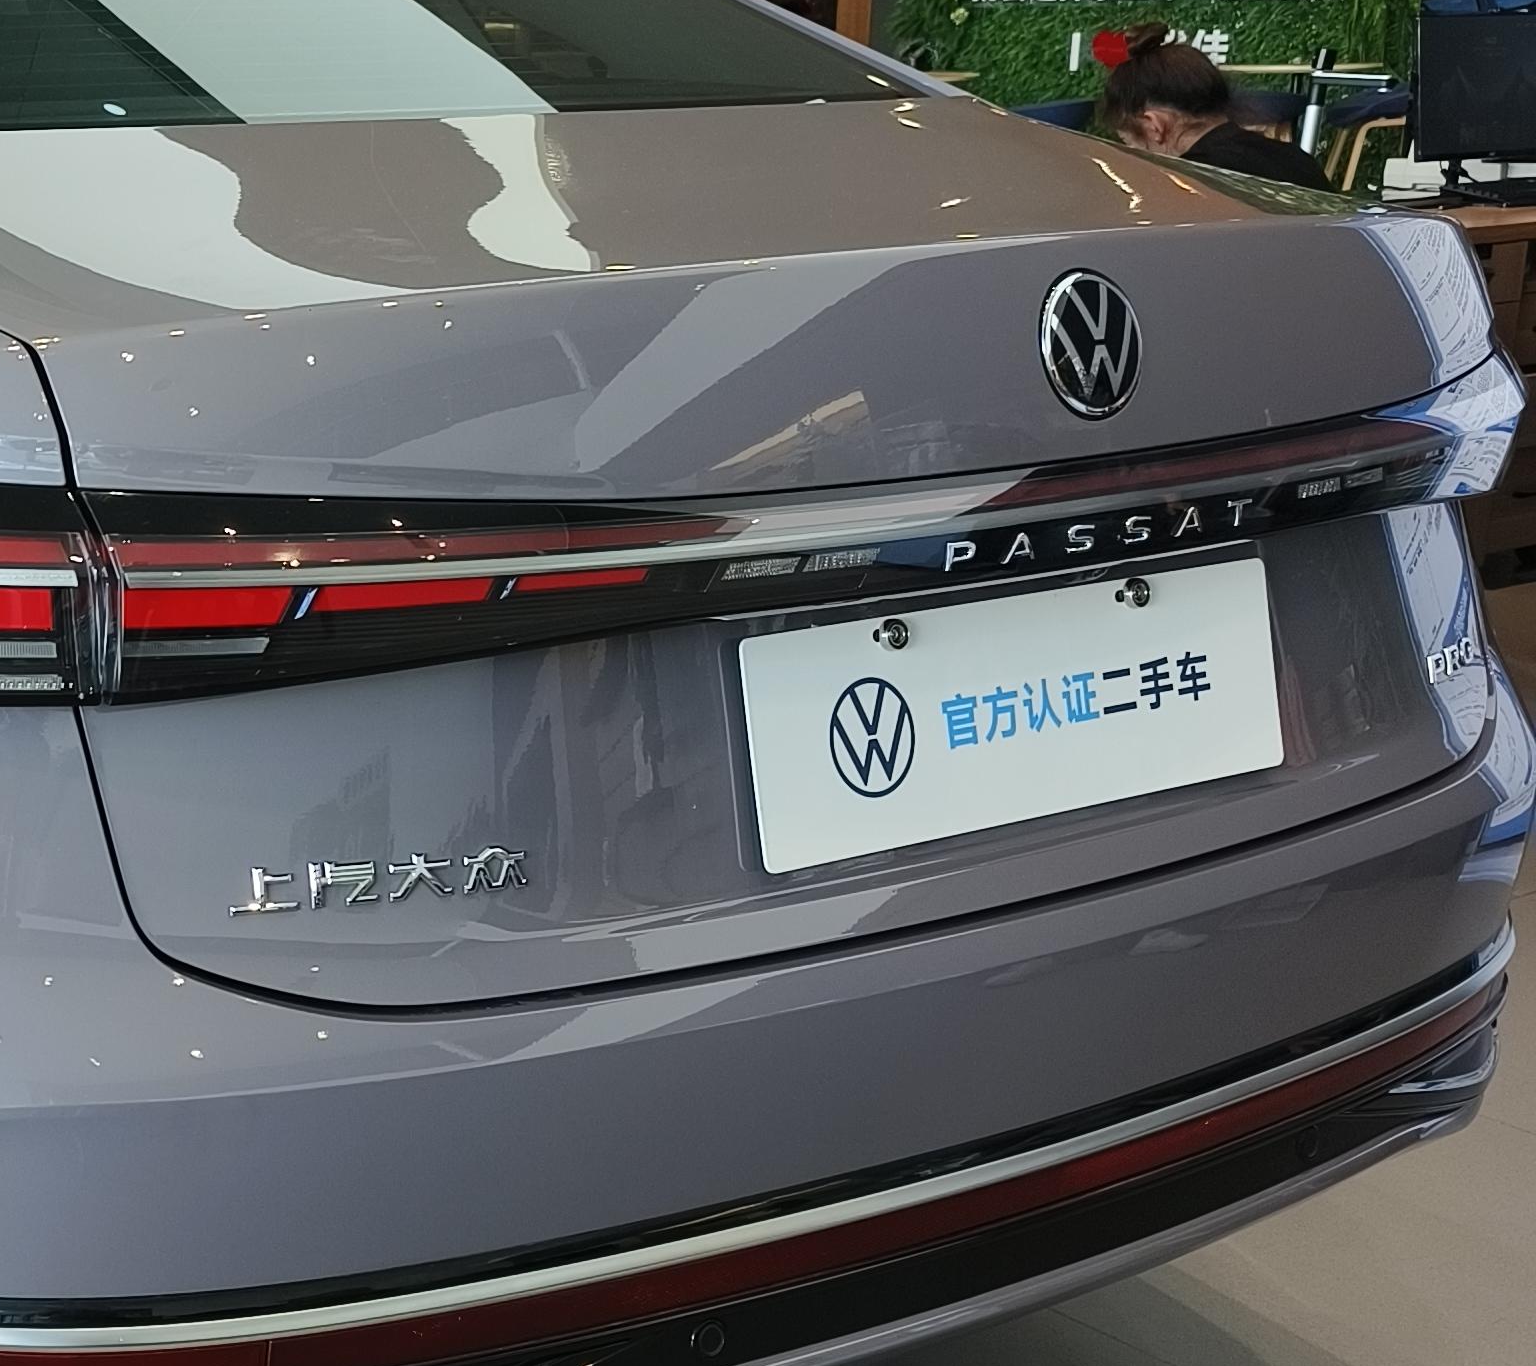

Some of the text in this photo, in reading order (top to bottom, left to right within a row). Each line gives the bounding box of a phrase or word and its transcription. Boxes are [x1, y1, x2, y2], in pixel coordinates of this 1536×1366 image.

[944, 498, 1253, 572] PASSAT
[940, 651, 1212, 750] 官方认证二手车
[227, 845, 528, 918] 上汽大众
